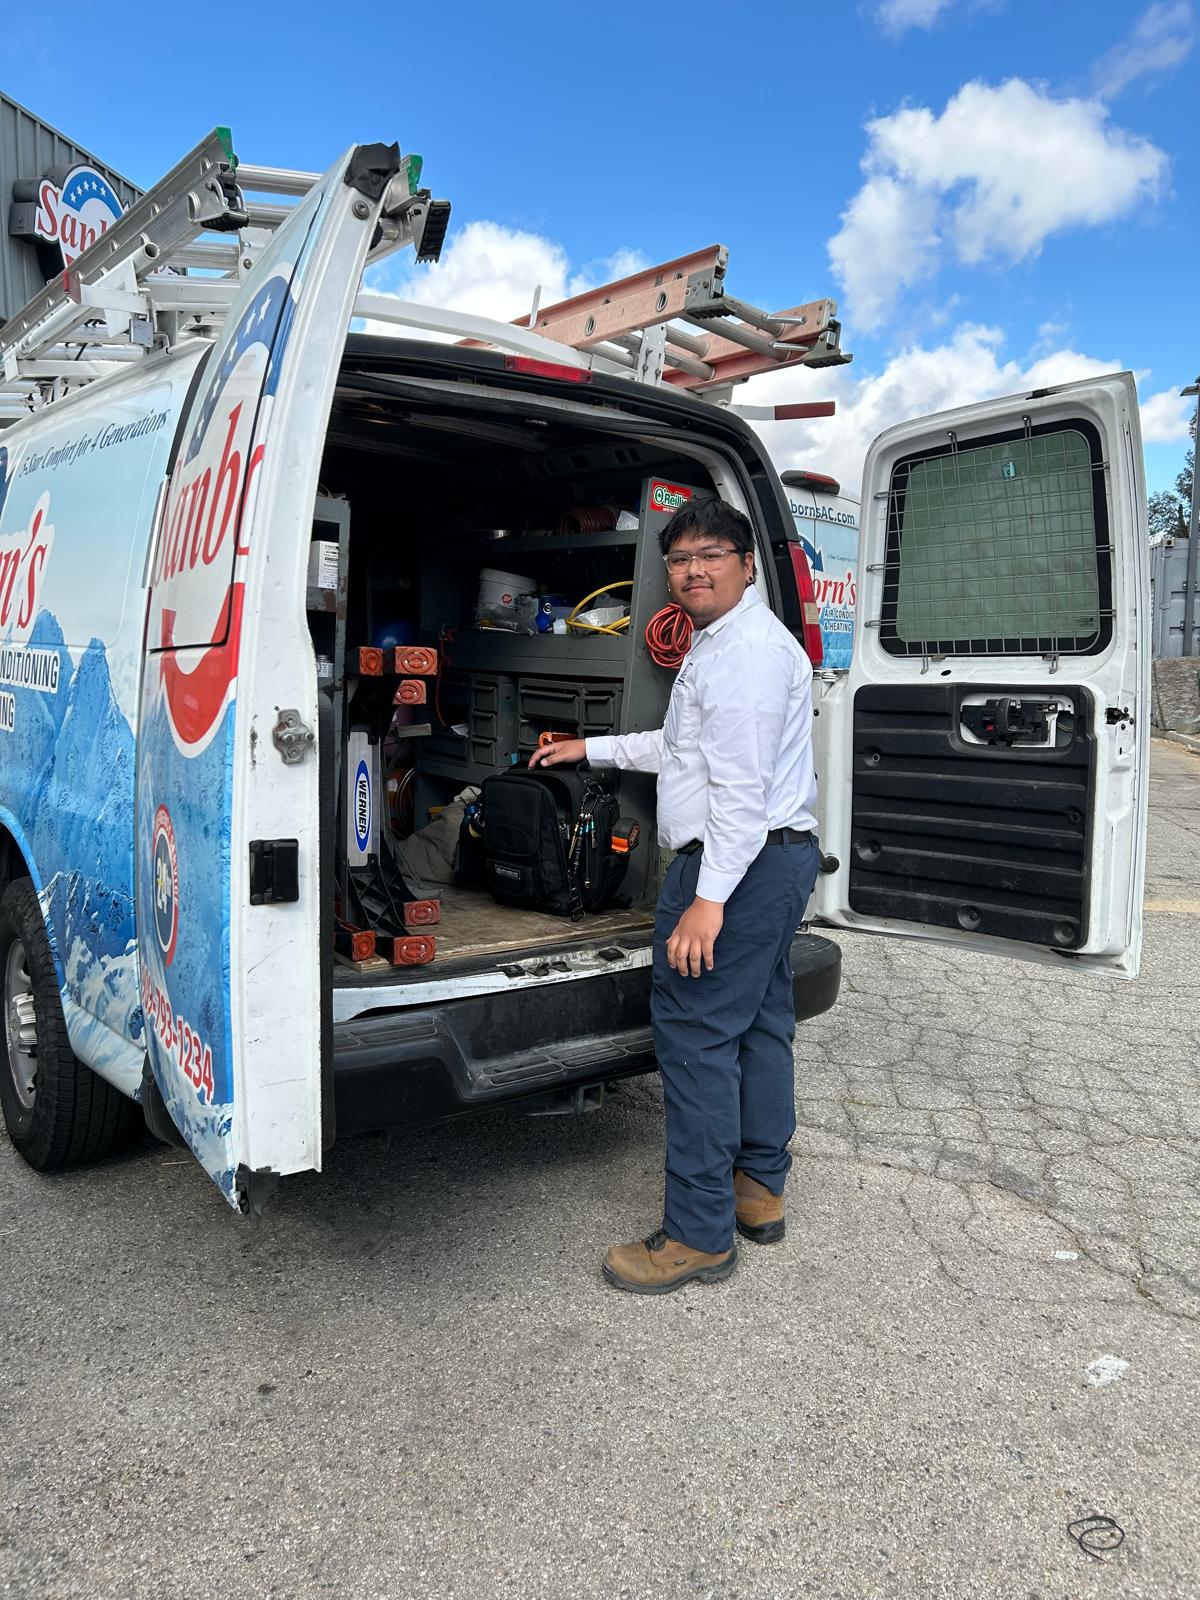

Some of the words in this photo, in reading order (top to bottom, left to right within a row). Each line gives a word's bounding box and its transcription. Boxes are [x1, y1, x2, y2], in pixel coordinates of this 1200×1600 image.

[41, 440, 77, 471] Comfort
[69, 434, 93, 466] for
[99, 408, 171, 449] Generations
[654, 486, 687, 507] O'Reill
[830, 622, 852, 632] HEATING
[359, 780, 367, 835] WERNER
